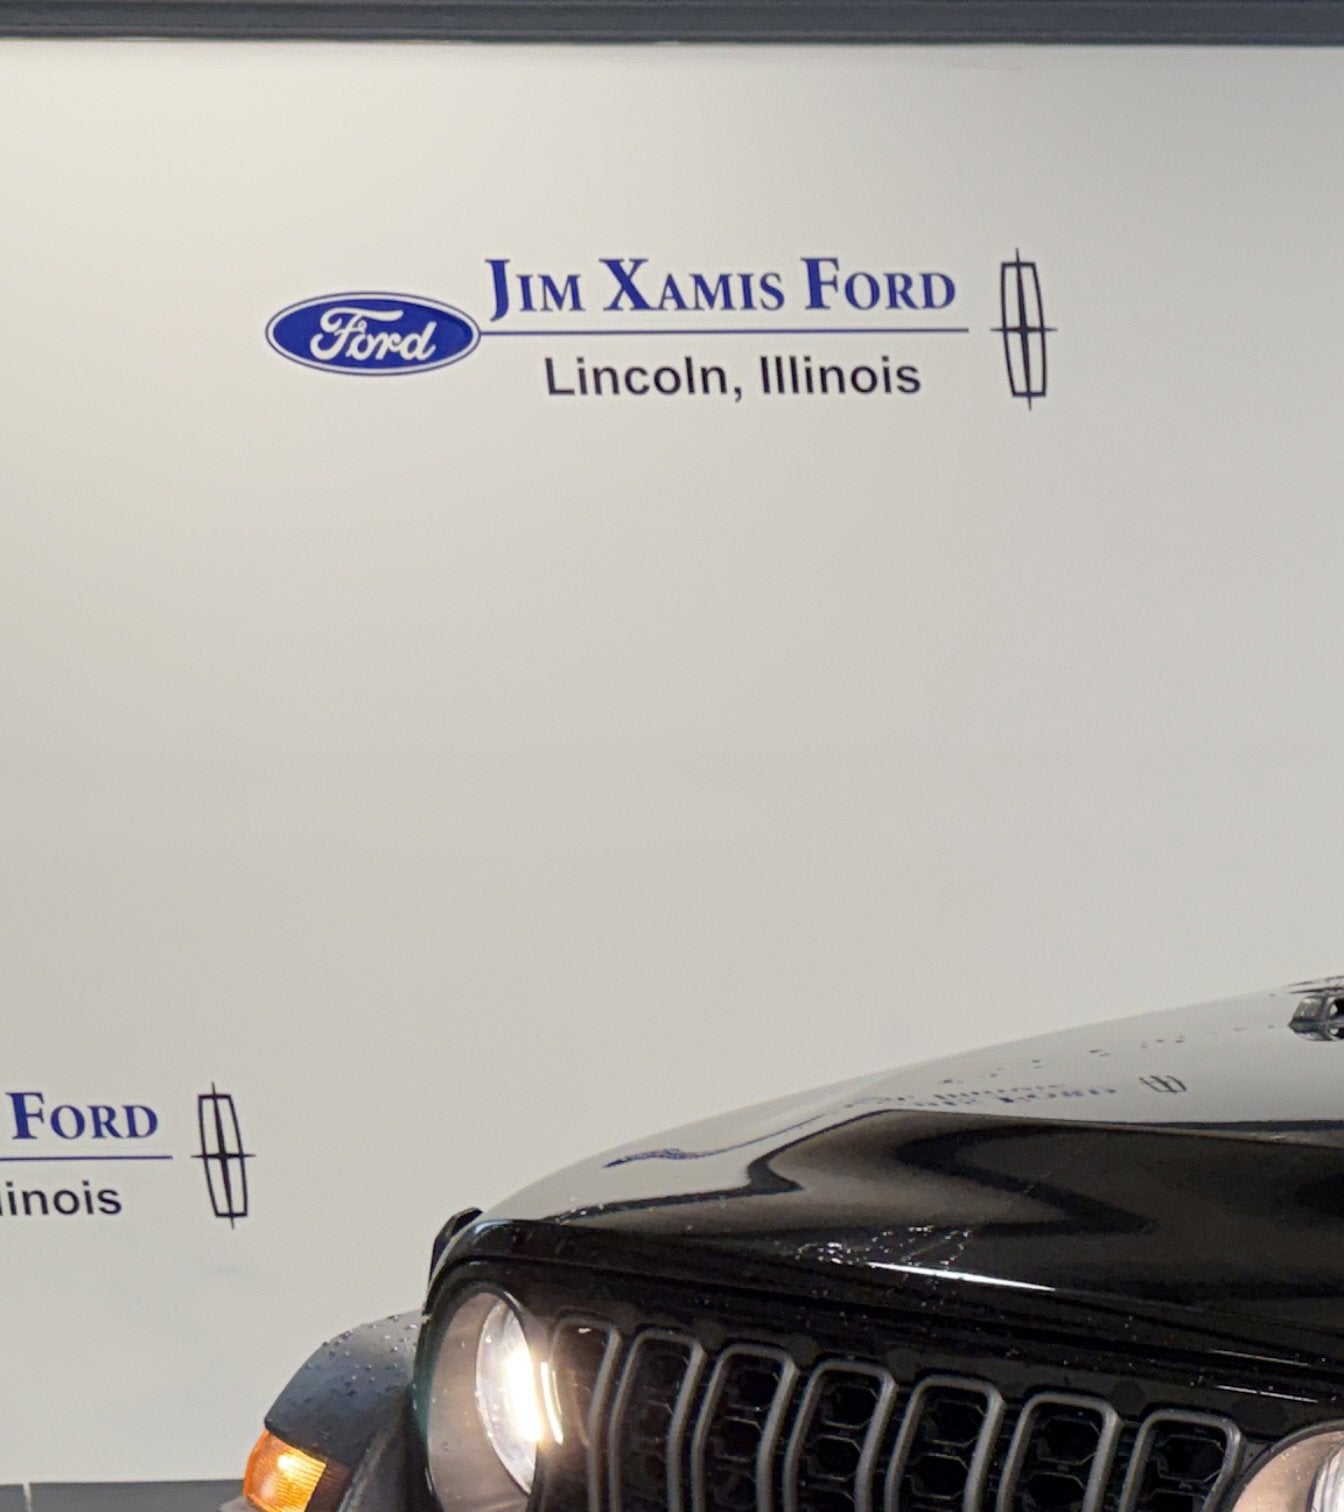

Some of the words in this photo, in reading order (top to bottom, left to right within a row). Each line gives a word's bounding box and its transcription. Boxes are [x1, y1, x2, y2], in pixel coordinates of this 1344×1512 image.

[486, 259, 584, 322] JIM
[600, 258, 785, 311] XAMIS
[800, 257, 957, 311] FORD
[309, 309, 437, 362] Ford
[544, 356, 742, 402] Lincoln,
[760, 355, 922, 394] Illinois
[5, 1091, 159, 1140] FORD
[0, 1179, 122, 1217] inois
